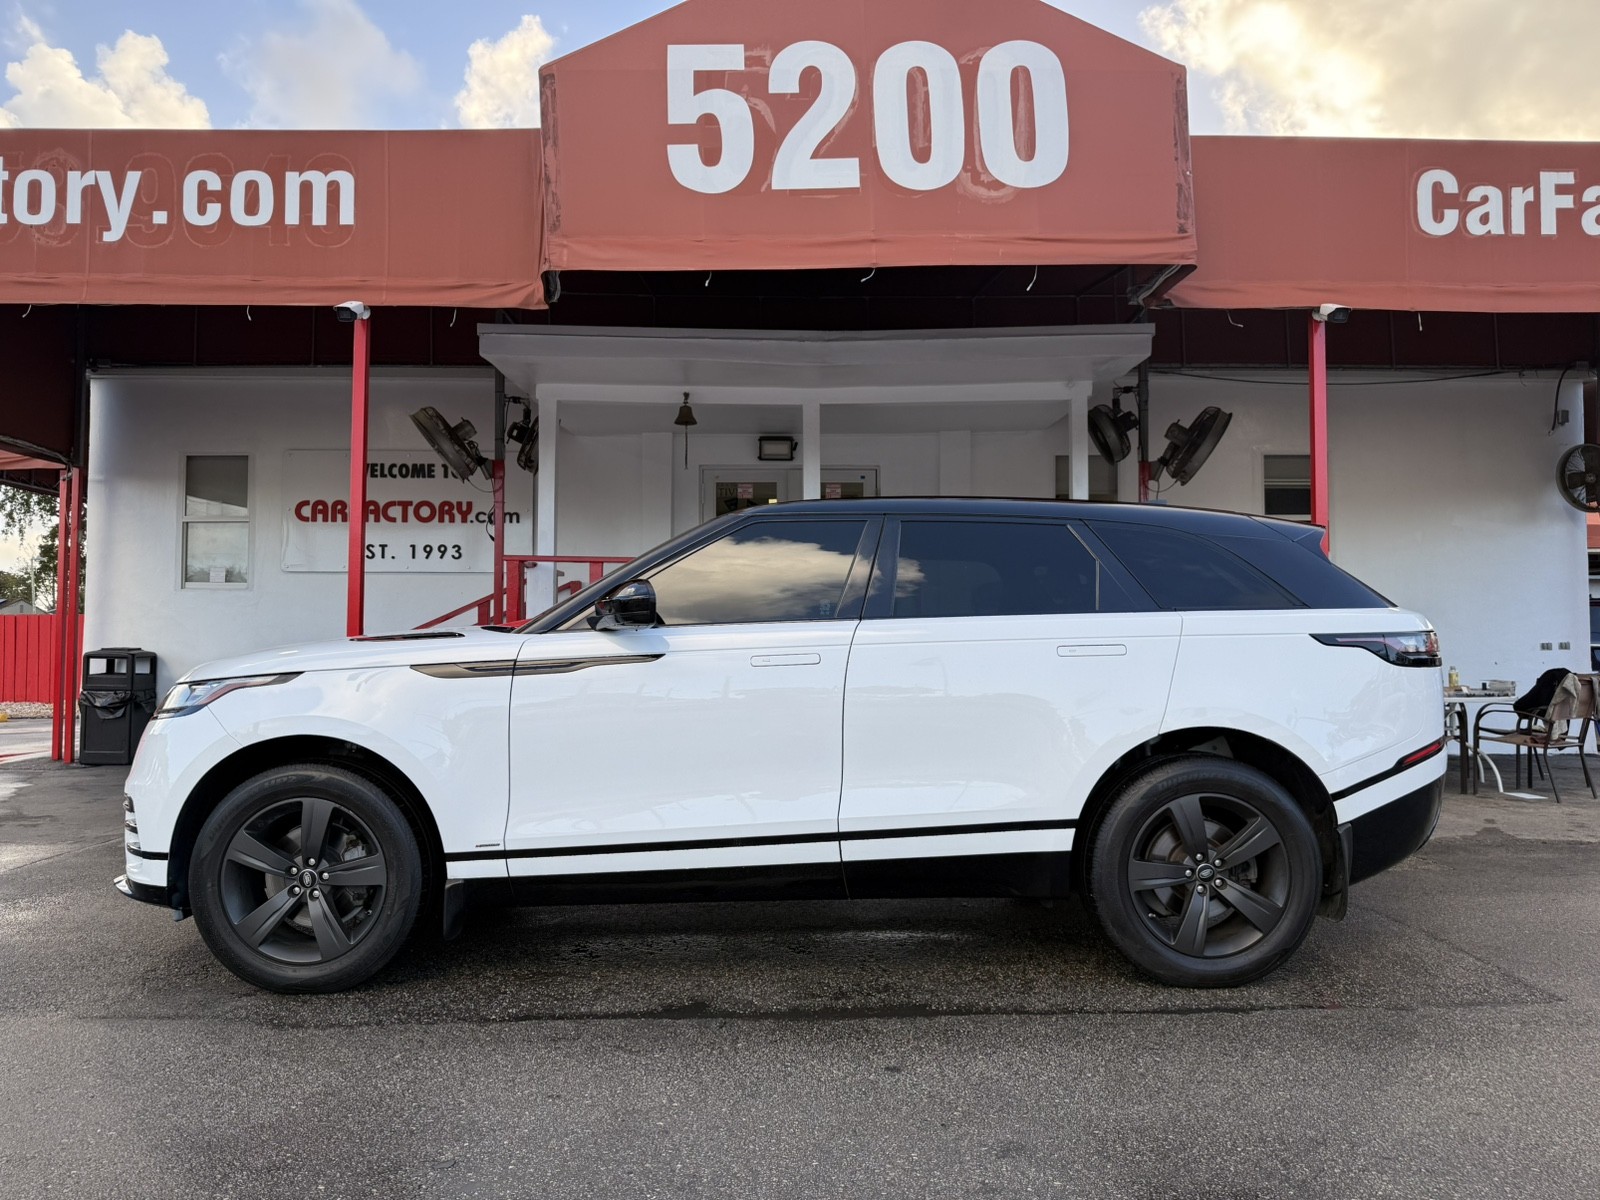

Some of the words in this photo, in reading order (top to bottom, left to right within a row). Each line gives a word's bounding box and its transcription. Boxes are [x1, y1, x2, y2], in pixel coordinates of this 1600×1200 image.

[667, 40, 1070, 194] 5200
[366, 463, 436, 479] ELCOME
[441, 463, 459, 479] T
[294, 499, 520, 524] CARACTORY.cm
[366, 544, 396, 560] ST.
[410, 544, 463, 560] 1993
